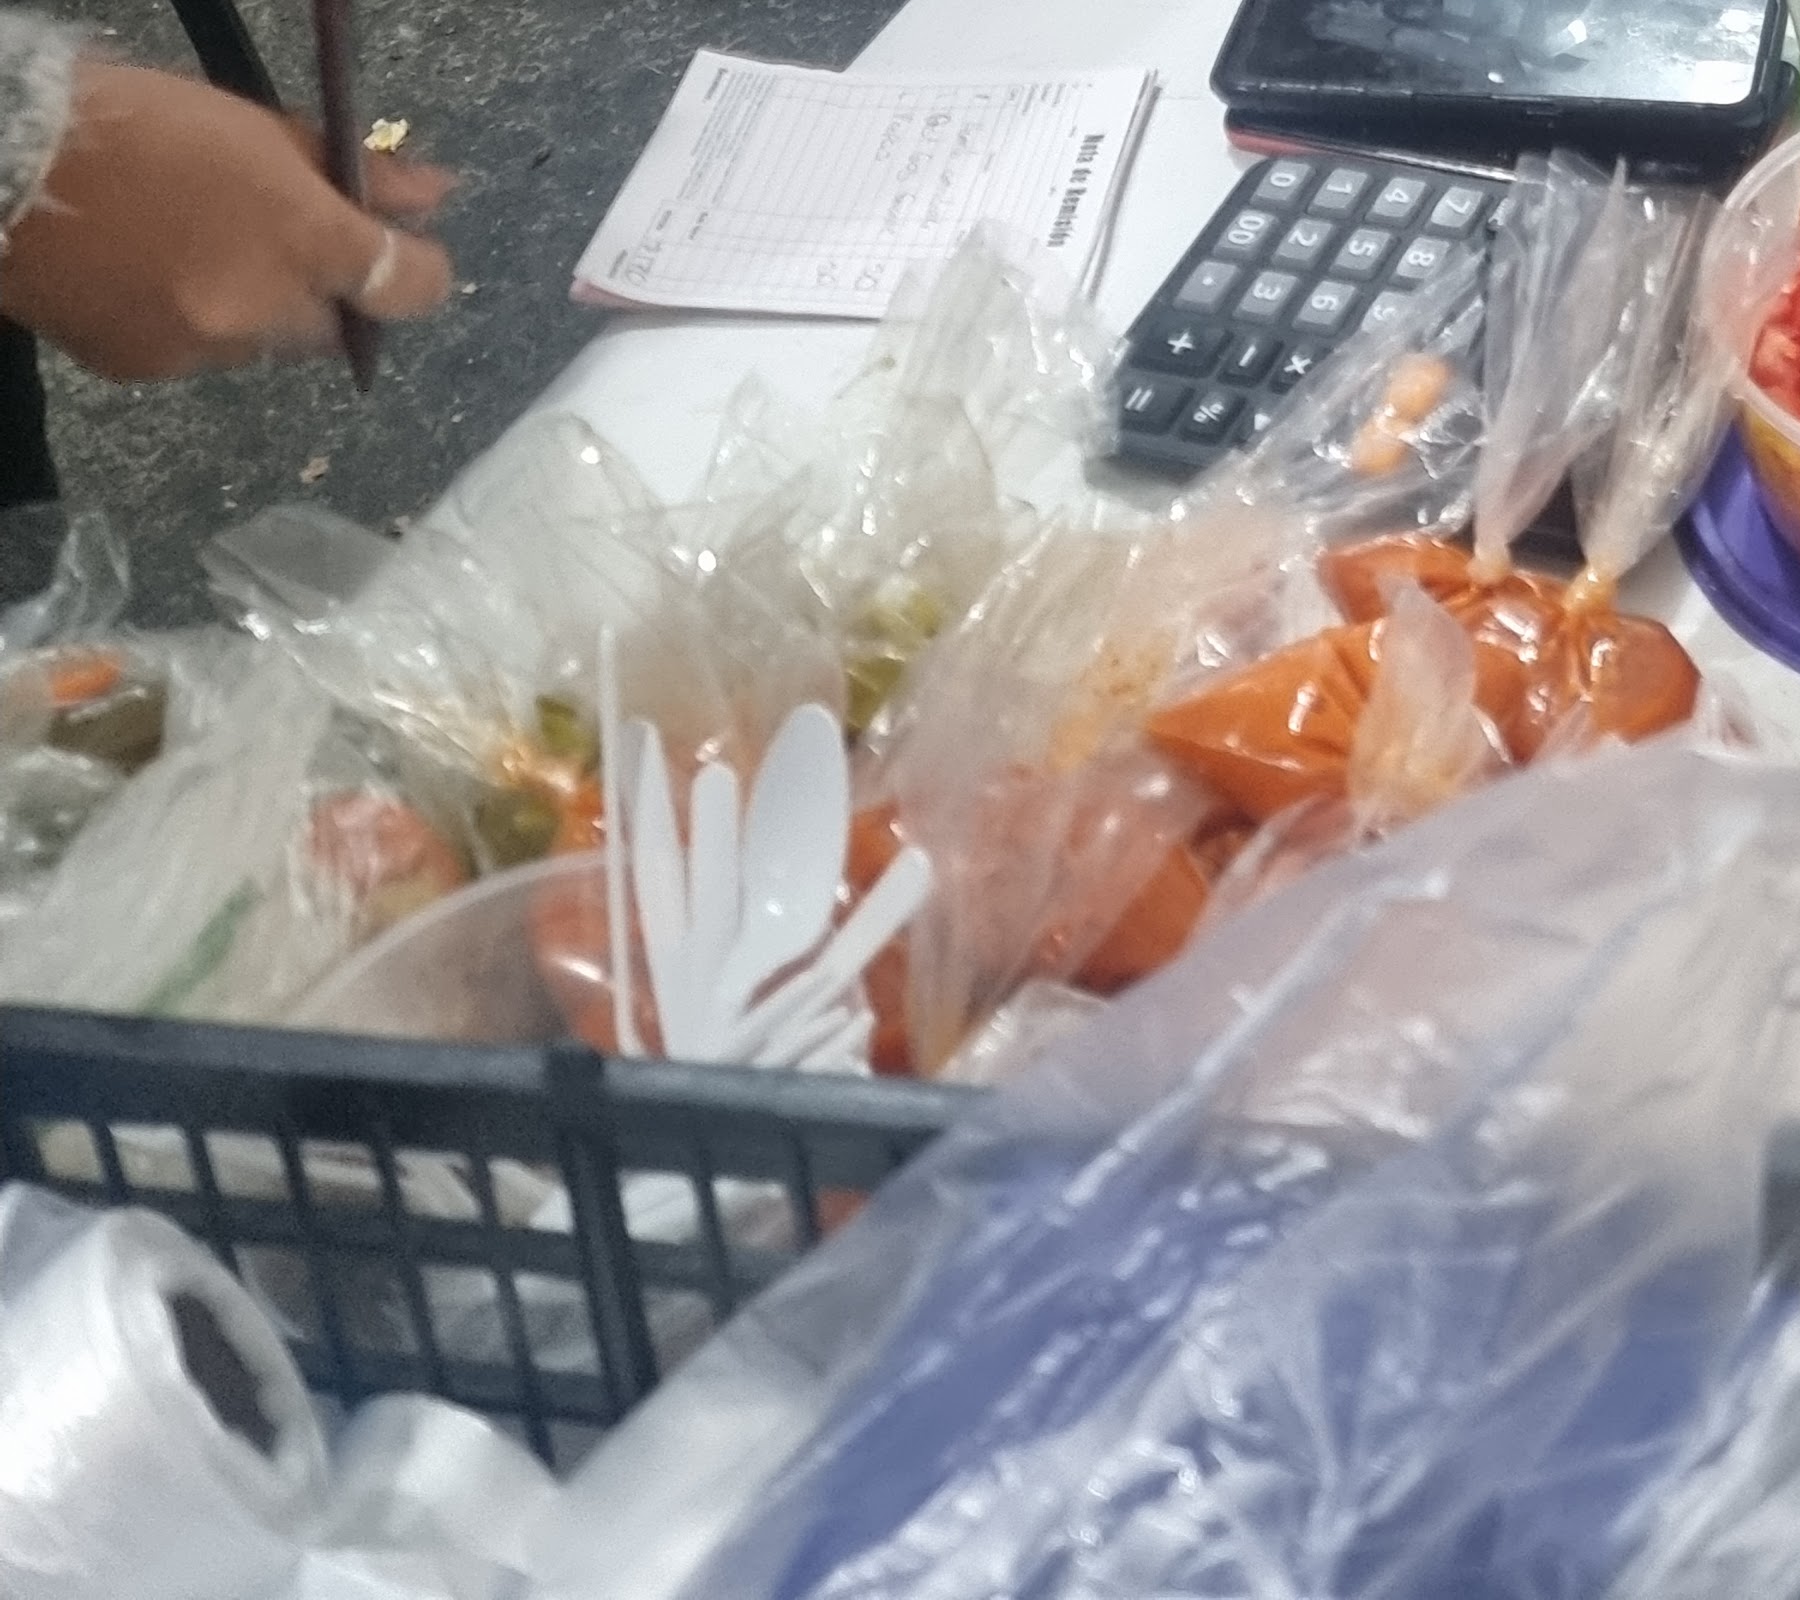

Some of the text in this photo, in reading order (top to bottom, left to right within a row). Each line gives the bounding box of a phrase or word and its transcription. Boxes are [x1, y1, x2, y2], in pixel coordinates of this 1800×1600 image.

[1046, 133, 1105, 248] Nota de Remisión
[1227, 170, 1297, 246] 0 00
[1446, 200, 1472, 216] 7
[1252, 179, 1353, 302] 1 2 3
[1311, 188, 1411, 312] 4 5 6
[1407, 249, 1435, 267] 8
